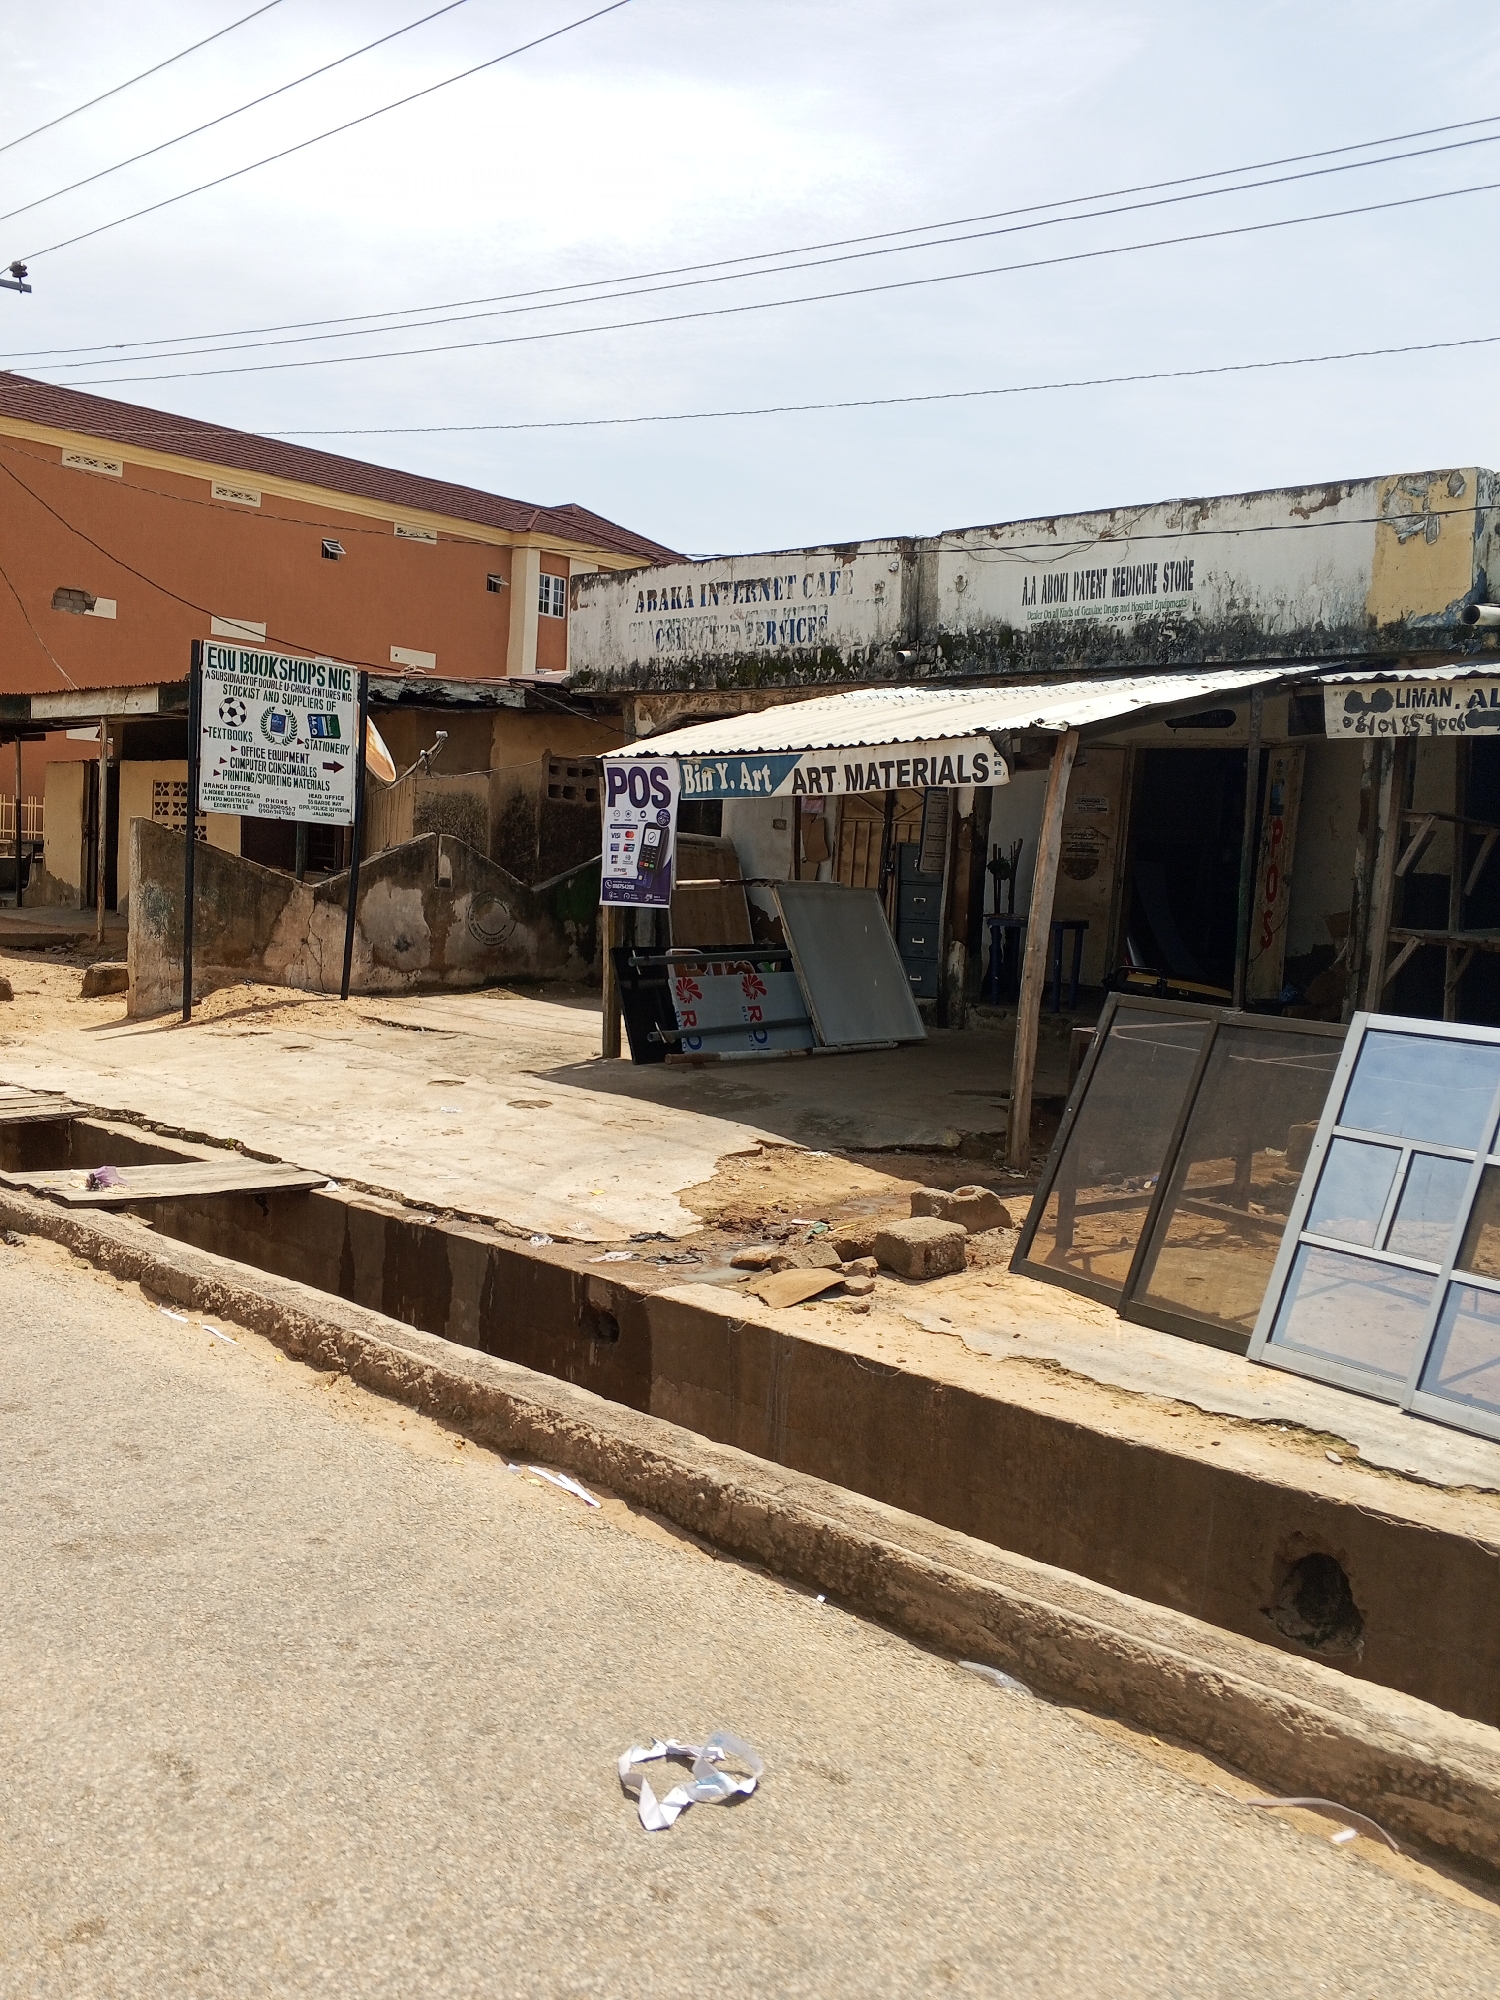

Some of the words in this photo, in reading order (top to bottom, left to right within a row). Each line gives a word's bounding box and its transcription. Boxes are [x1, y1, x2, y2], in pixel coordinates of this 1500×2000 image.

[635, 585, 694, 613] ABAKA
[699, 574, 796, 608] INTERNET
[803, 570, 853, 599] CAFE
[1040, 572, 1068, 604] ABOKI
[1073, 568, 1107, 601] PATENT
[1111, 562, 1157, 598] MEDICINE
[1162, 559, 1194, 593] STORE
[1026, 609, 1042, 620] Dealer
[1059, 607, 1073, 618] Kinds
[1074, 605, 1081, 616] of
[1081, 604, 1102, 616] Genuine
[1103, 604, 1118, 616] Drugs
[1119, 602, 1129, 612] and
[1130, 599, 1153, 613] Hospital
[211, 669, 249, 685] SUBSIDIARY
[249, 677, 258, 688] OF
[258, 678, 282, 690] DOUBLE
[328, 667, 353, 692] NIG.
[223, 684, 260, 700] STOCKIST
[263, 691, 279, 703] AND
[282, 692, 323, 712] SUPPLIERS
[326, 701, 336, 713] OF
[208, 726, 253, 743] TEXTBOOKS
[240, 746, 265, 759] OFFICE
[268, 749, 310, 764] EQUIPMENT
[304, 738, 350, 756] STATIONERY
[230, 757, 266, 773] COMPUTER
[268, 761, 317, 778] CONSUMABLES
[683, 764, 713, 795] Bin
[716, 762, 735, 791] Y.
[740, 761, 772, 793] Art
[792, 765, 837, 795] ART
[844, 752, 990, 792] MATERIALS
[203, 782, 228, 790] BRANCH
[230, 784, 251, 792] OFFICE
[293, 776, 330, 791] MATERIALS
[606, 766, 671, 809] POS
[265, 797, 288, 805] PHONE
